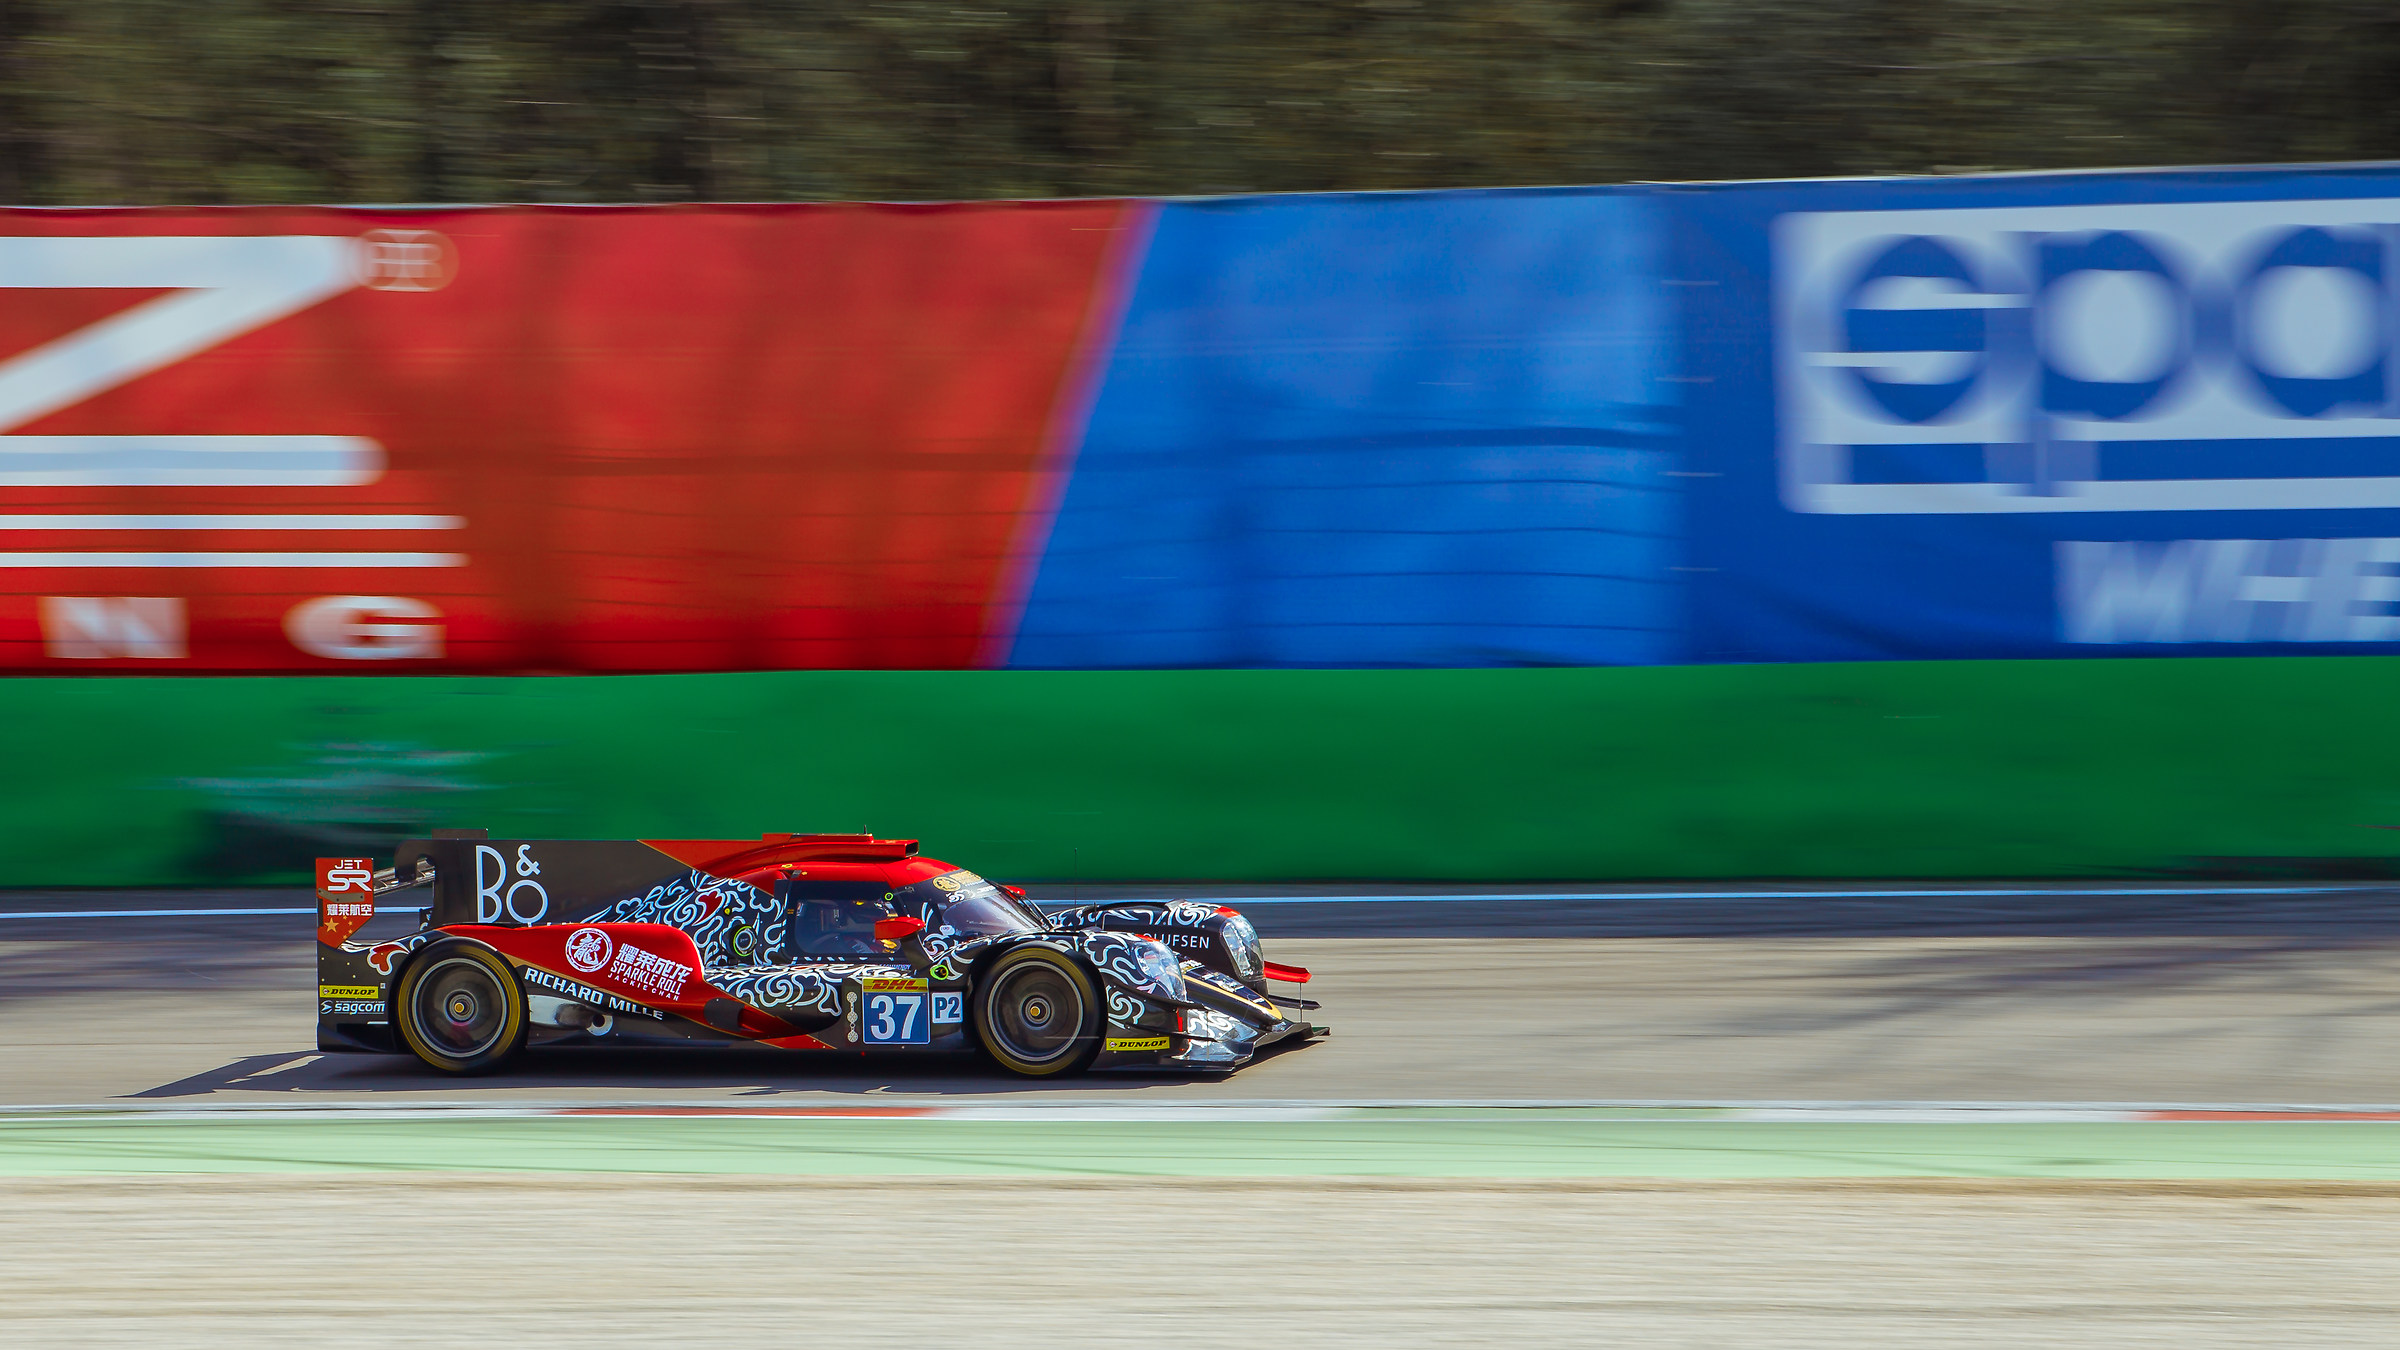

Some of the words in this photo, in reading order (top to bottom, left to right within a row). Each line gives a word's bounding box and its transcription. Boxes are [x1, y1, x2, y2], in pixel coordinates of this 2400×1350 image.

[334, 859, 363, 870] JET
[327, 869, 373, 892] SR
[607, 973, 649, 992] JACKIE
[610, 960, 658, 987] SPARKLE
[656, 976, 683, 995] ROLL
[871, 979, 920, 990] DHL
[524, 967, 604, 1005] RICHARD
[608, 996, 665, 1021] MILLE
[334, 1003, 386, 1015] sagcom
[870, 995, 923, 1040] 37
[934, 997, 961, 1019] P2
[1119, 1040, 1167, 1048] DUNLOP
